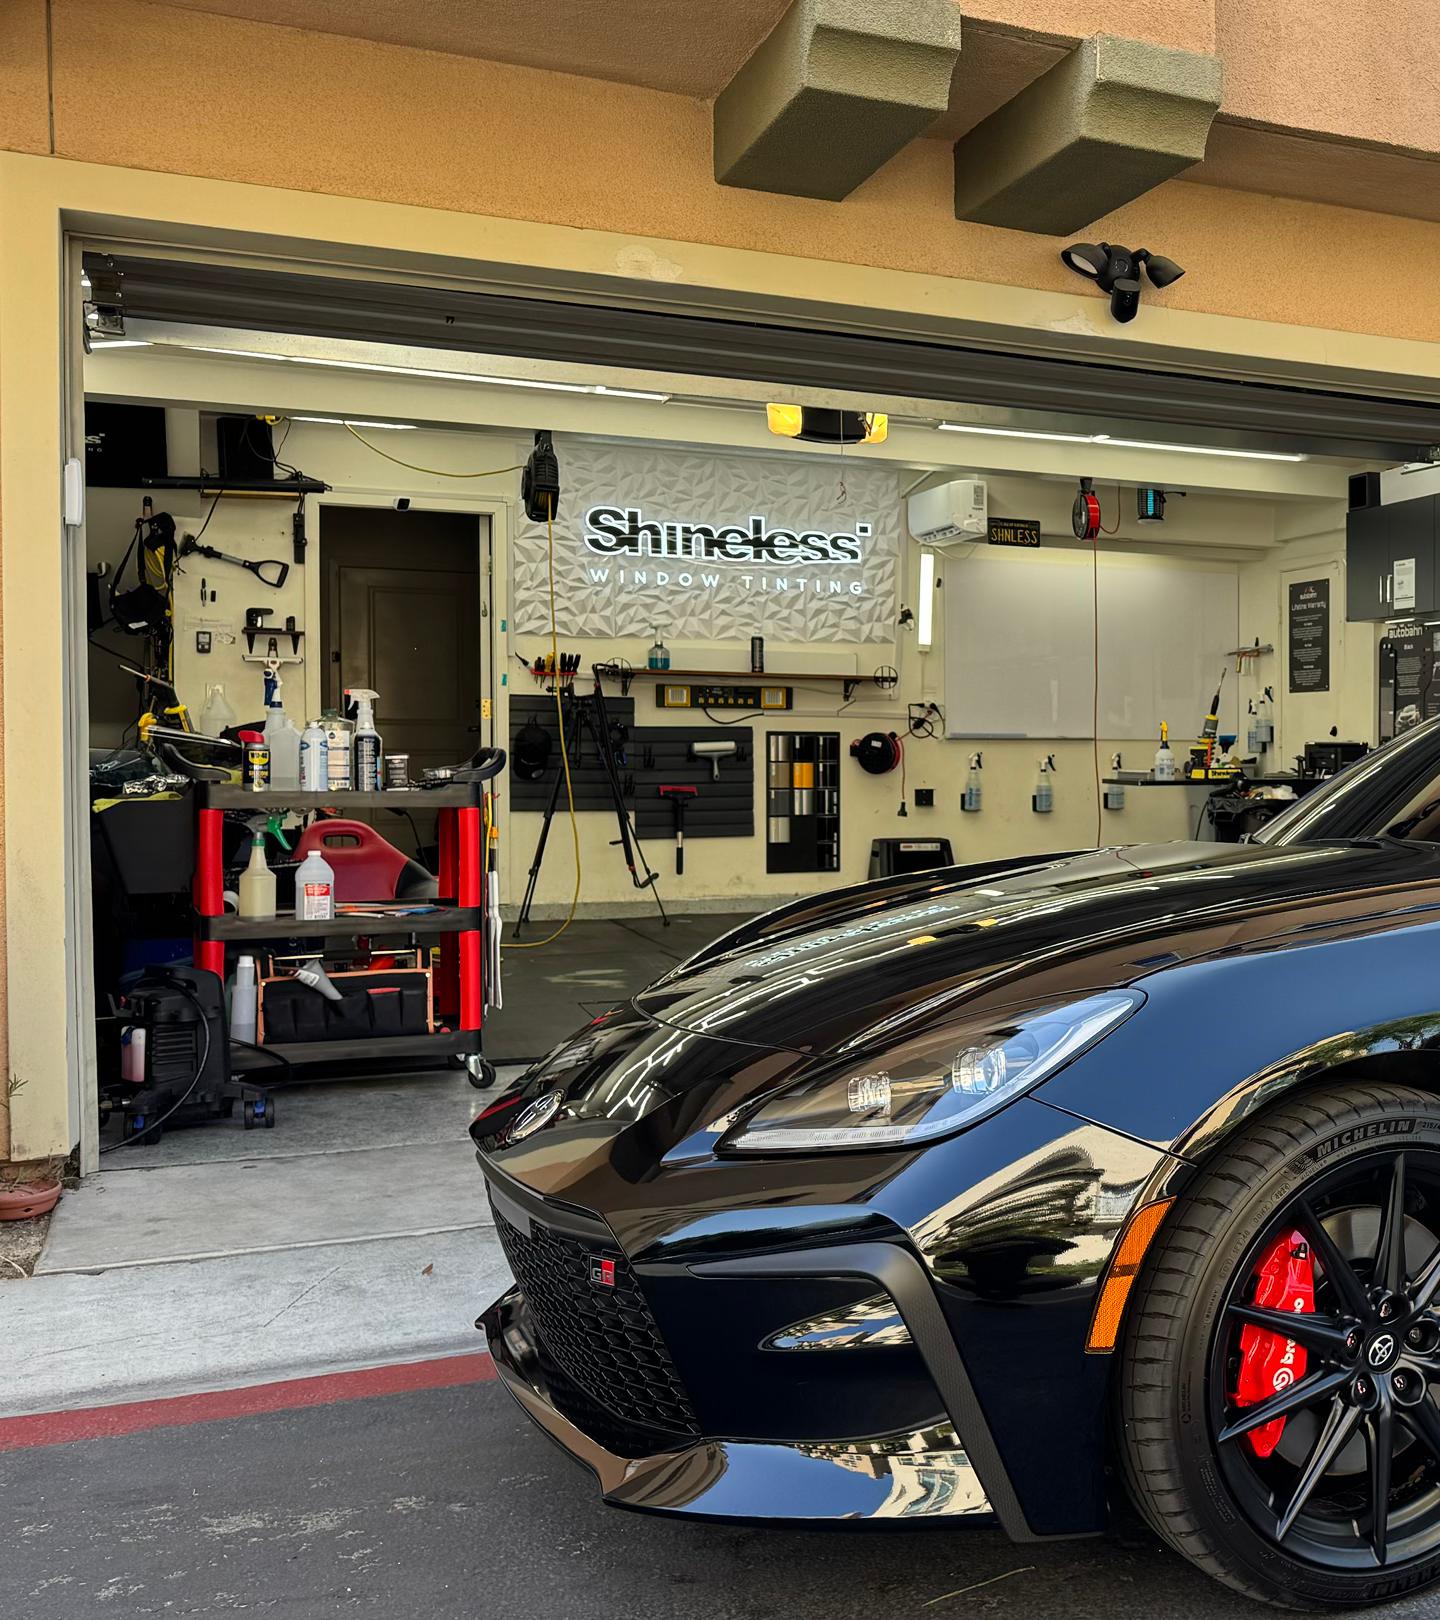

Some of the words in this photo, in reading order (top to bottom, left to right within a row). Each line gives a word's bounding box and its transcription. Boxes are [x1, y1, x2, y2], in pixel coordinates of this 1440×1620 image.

[584, 505, 862, 565] Shineless
[991, 527, 1038, 544] SHNLESS
[590, 568, 720, 588] WINDOW
[742, 575, 863, 595] TINTING
[1389, 625, 1423, 639] autobahn
[1317, 1121, 1411, 1157] MICHELIN
[592, 1267, 614, 1285] GR
